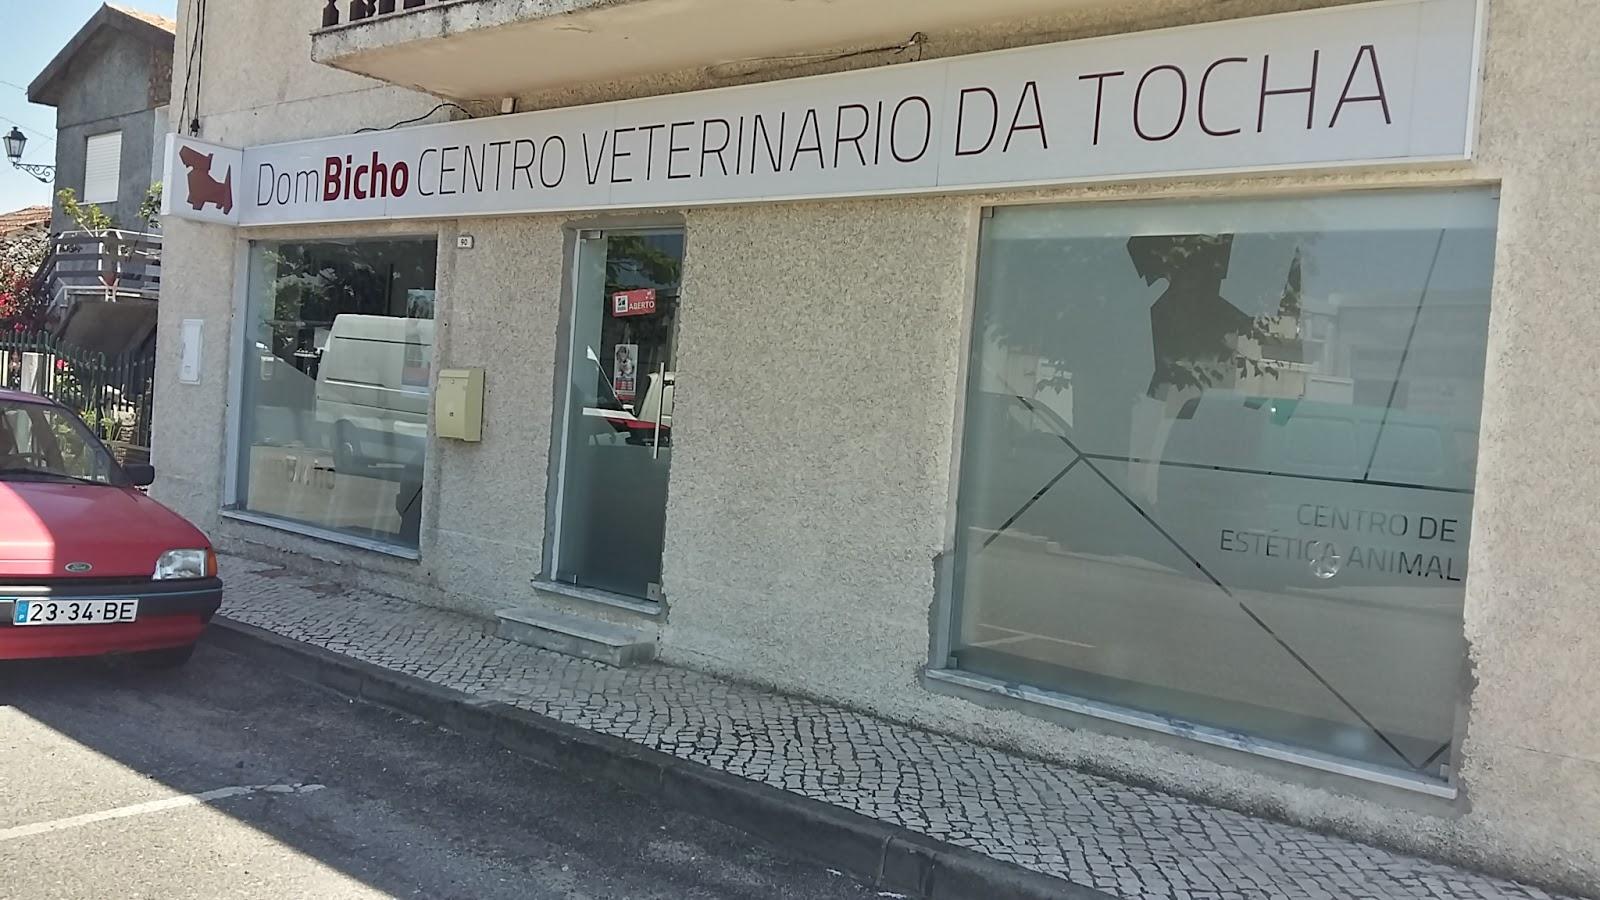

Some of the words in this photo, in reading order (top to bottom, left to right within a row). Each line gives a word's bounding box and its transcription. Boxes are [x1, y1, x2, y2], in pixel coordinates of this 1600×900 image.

[417, 135, 566, 196] CENTRO
[582, 95, 932, 185] VETERINARIO
[955, 81, 1048, 157] DA
[1078, 44, 1392, 145] TOCHA
[629, 300, 655, 310] ABERTO
[1296, 503, 1408, 537] CENTRO
[1418, 516, 1458, 543] DE
[1219, 528, 1338, 564] ESTÉTICA
[1348, 545, 1461, 582] ANIMAL
